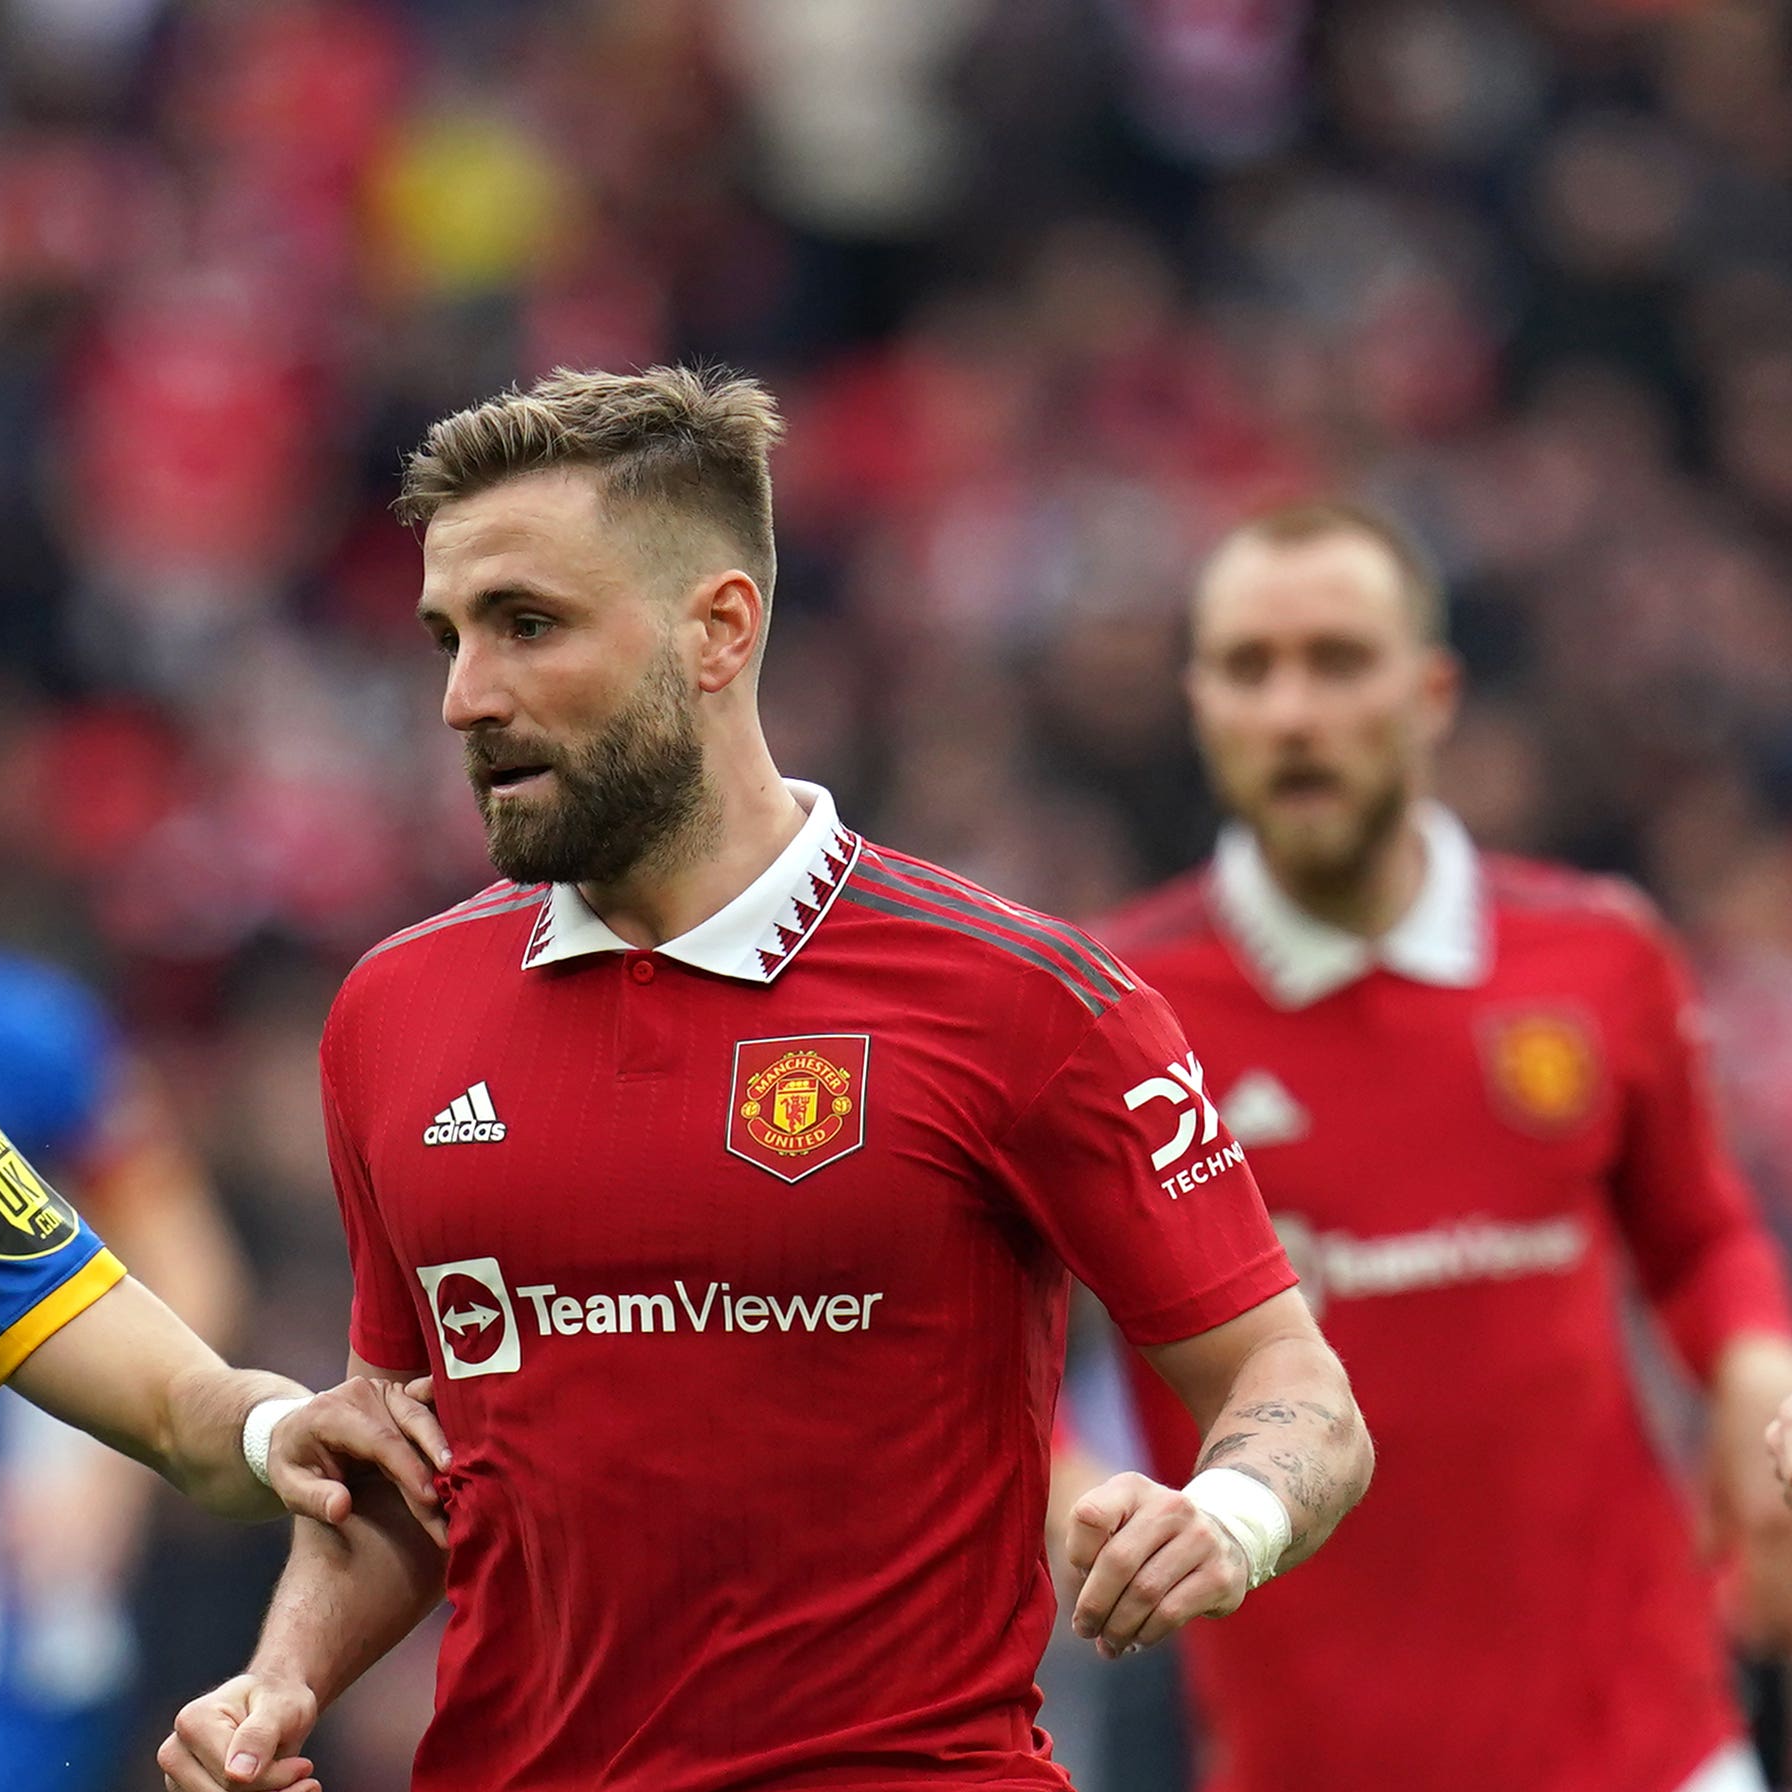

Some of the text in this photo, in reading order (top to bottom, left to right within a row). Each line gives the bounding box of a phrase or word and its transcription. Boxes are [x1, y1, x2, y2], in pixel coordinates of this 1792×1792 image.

[755, 1058, 841, 1094] MANCHESTER
[422, 1119, 507, 1146] adidas
[764, 1128, 825, 1149] UNITED
[515, 1279, 883, 1337] TeamViewer
